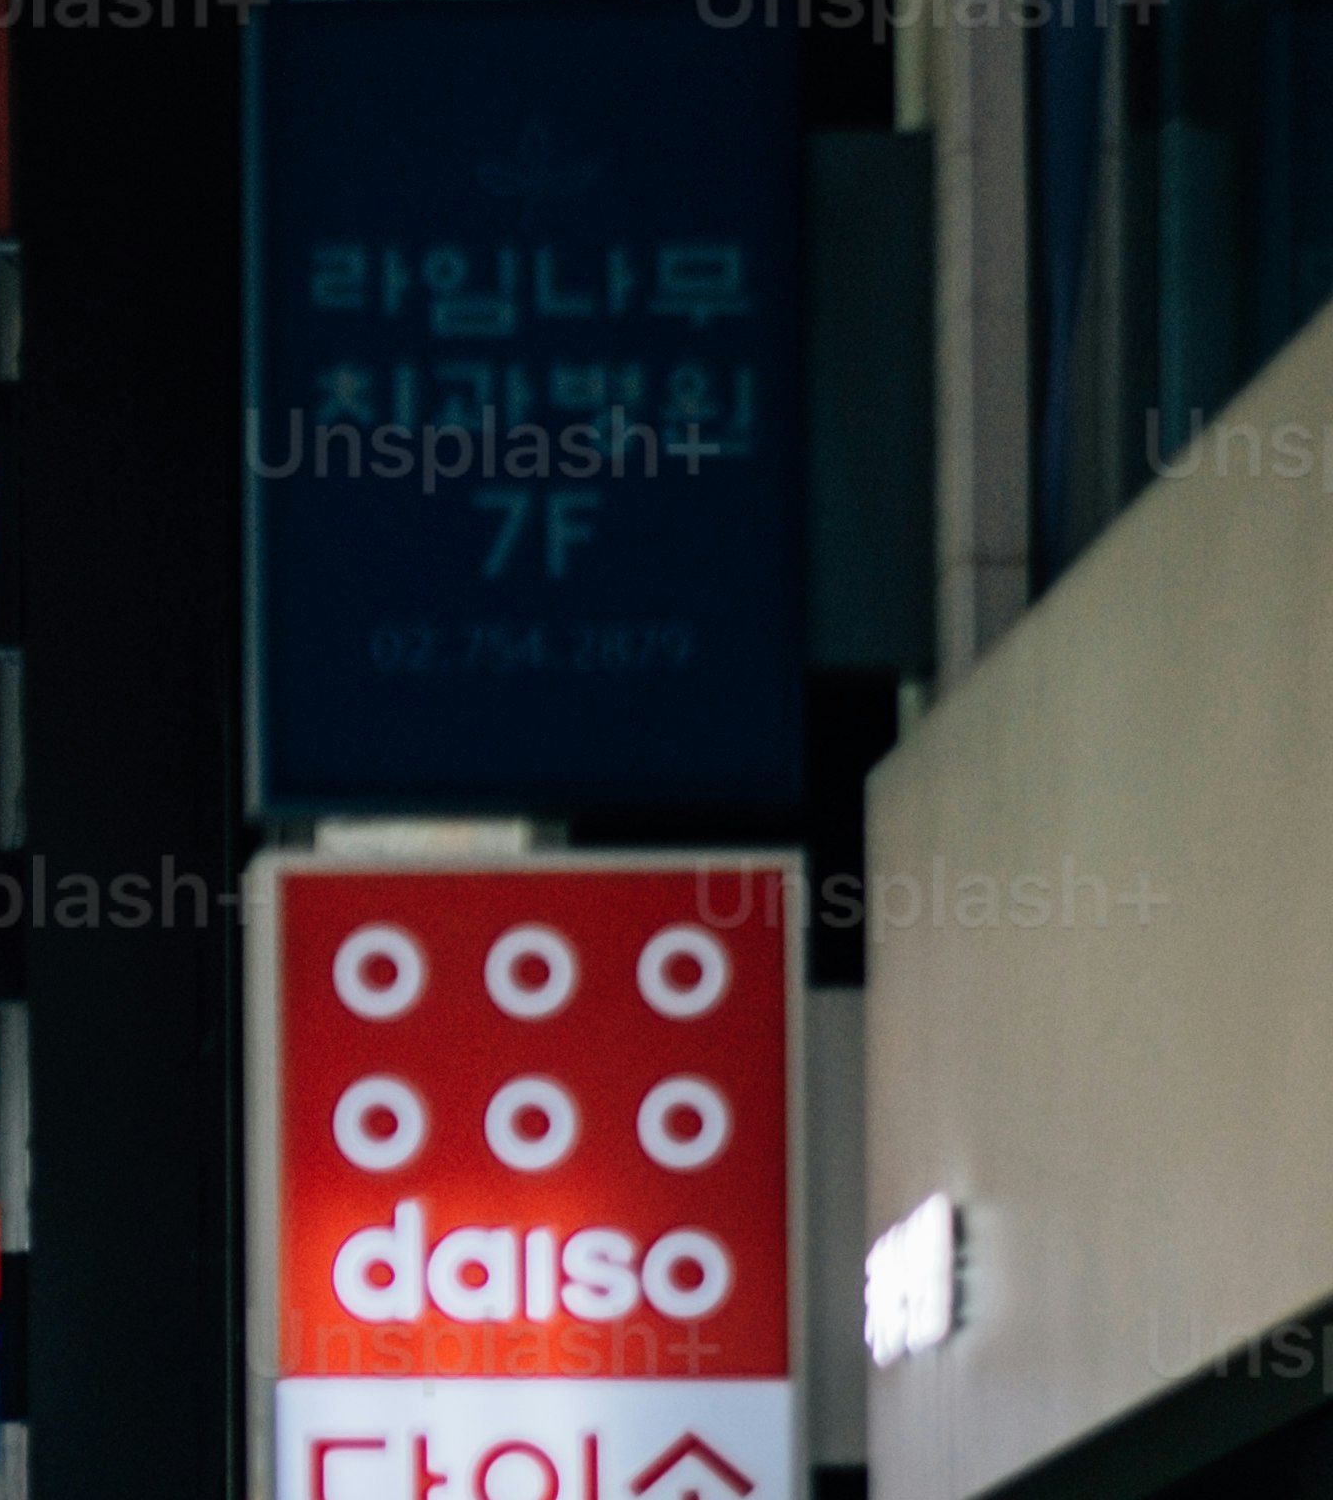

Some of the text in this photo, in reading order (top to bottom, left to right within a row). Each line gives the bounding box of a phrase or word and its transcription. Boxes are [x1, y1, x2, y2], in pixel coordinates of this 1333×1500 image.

[309, 243, 750, 338] 라임나무
[472, 492, 605, 580] 7F
[332, 1197, 734, 1324] daiso
